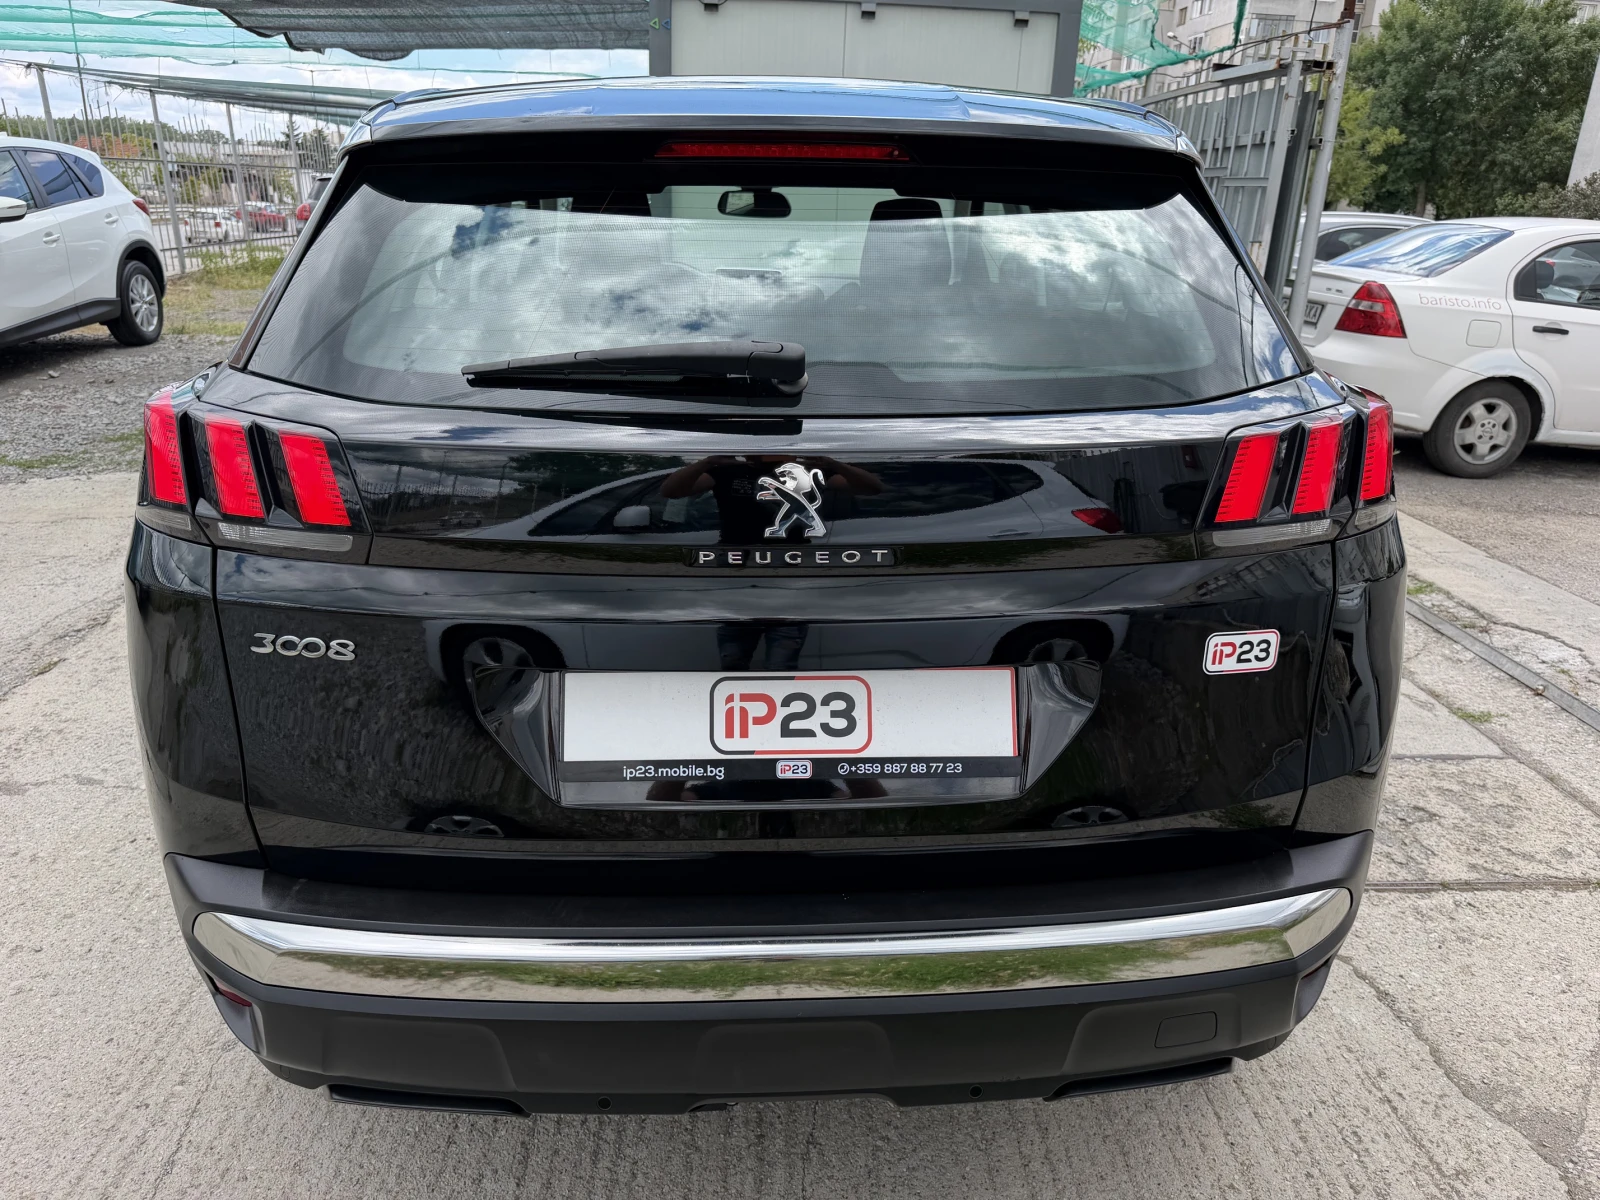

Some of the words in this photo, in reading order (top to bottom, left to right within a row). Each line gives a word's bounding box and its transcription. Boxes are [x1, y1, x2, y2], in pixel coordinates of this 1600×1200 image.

[1418, 293, 1502, 311] baristo.info
[698, 549, 888, 565] PEUGEOT
[249, 632, 356, 661] 3008
[622, 764, 726, 780] ip23.mobile.bg
[850, 763, 882, 774] +359
[884, 762, 908, 774] 887
[910, 762, 927, 774] 88
[929, 762, 945, 774] 77
[946, 762, 963, 773] 23
